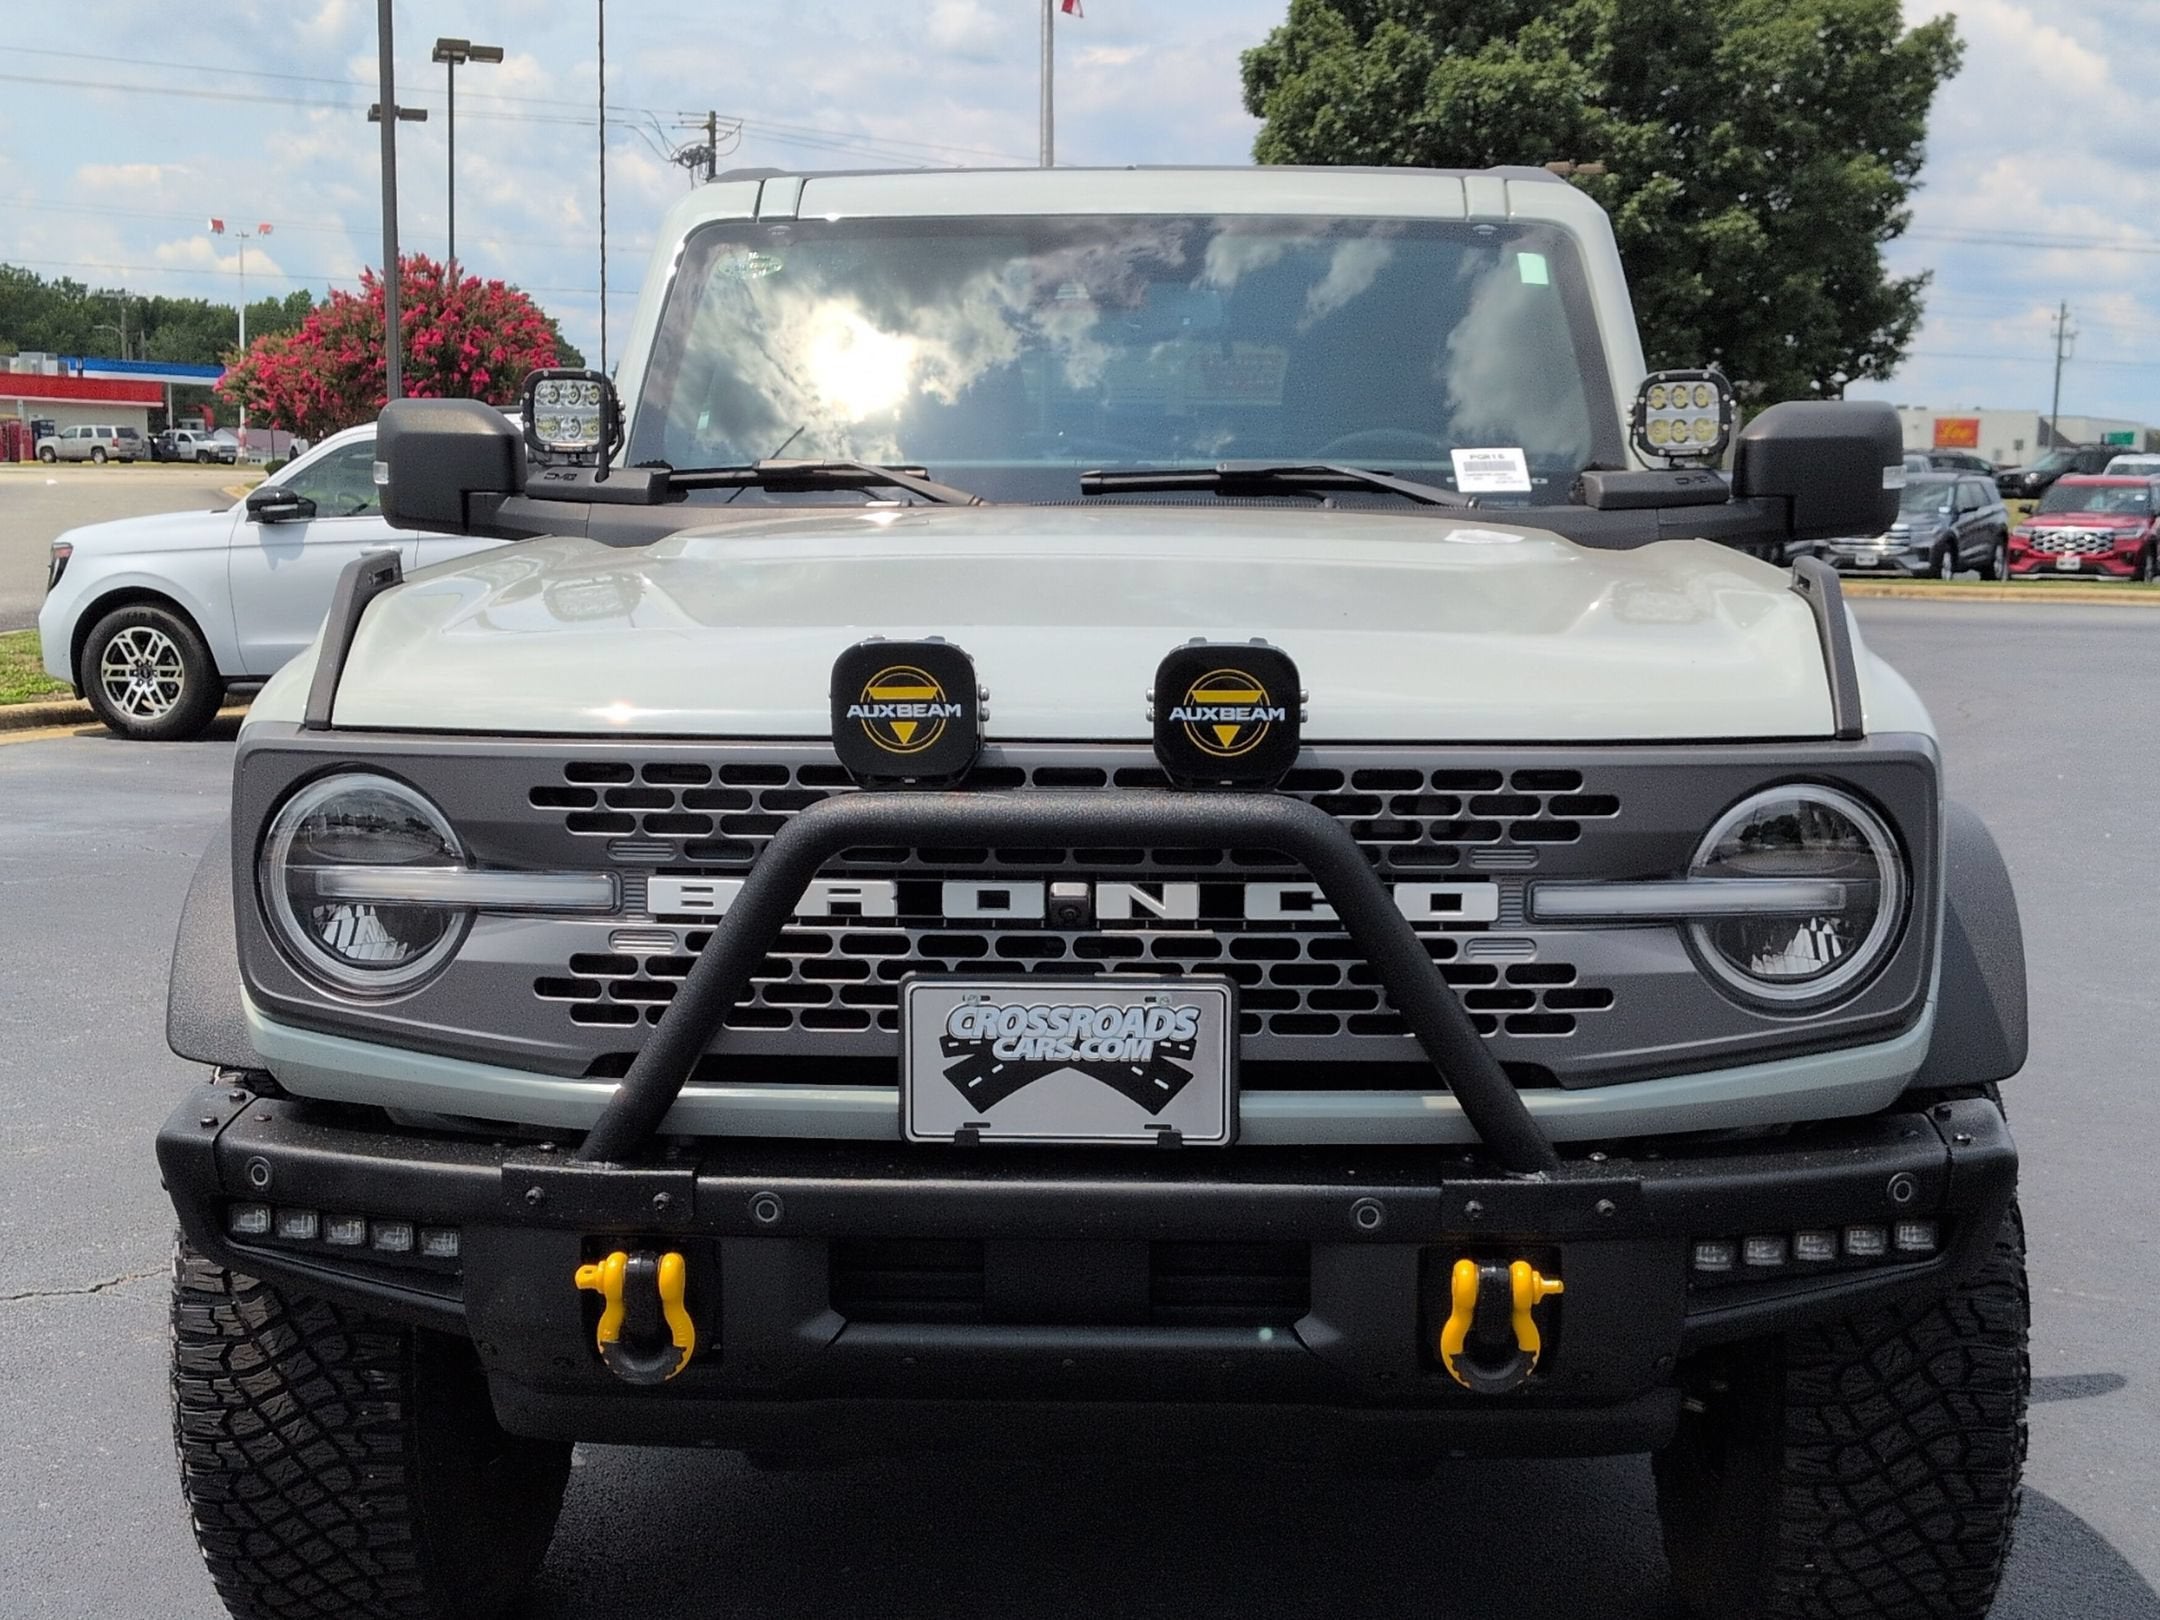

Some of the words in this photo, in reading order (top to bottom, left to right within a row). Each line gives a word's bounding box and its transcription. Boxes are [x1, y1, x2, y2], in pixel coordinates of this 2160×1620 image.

[846, 703, 962, 718] AUXBEAM
[1169, 706, 1285, 721] AUXBEAM
[647, 878, 1499, 921] BRONCO
[946, 1003, 1201, 1041] CROSSROADS
[992, 1037, 1156, 1062] CARS.COM
